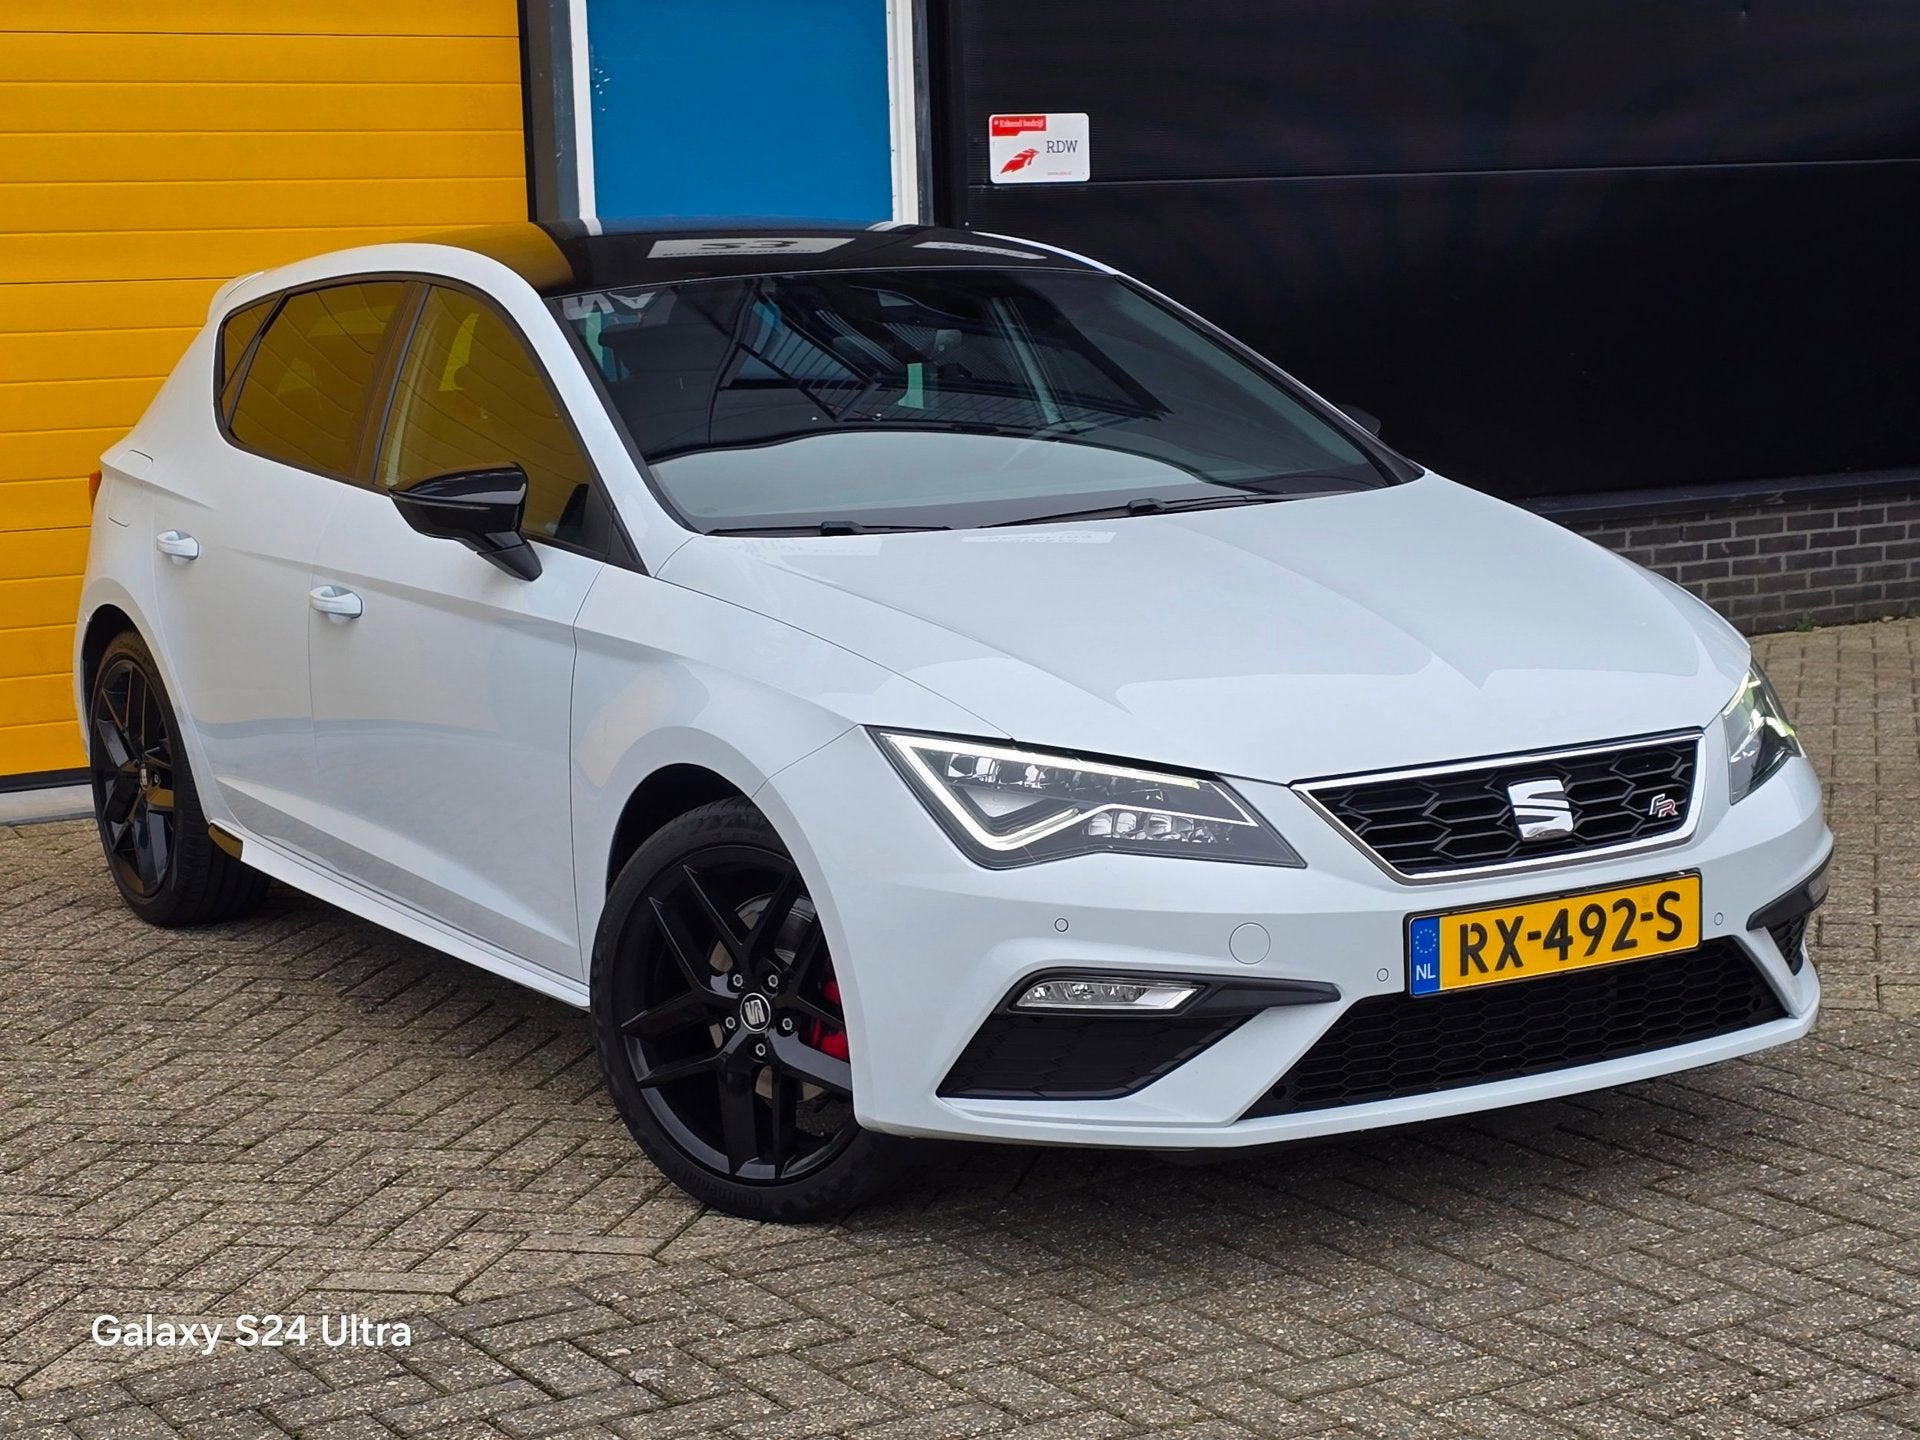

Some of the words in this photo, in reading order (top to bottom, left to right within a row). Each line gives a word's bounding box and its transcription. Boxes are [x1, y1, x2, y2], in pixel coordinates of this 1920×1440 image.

[1046, 140, 1078, 154] RDW
[1649, 793, 1678, 818] FR
[1459, 890, 1683, 977] RX-492-S
[1415, 963, 1436, 980] NL
